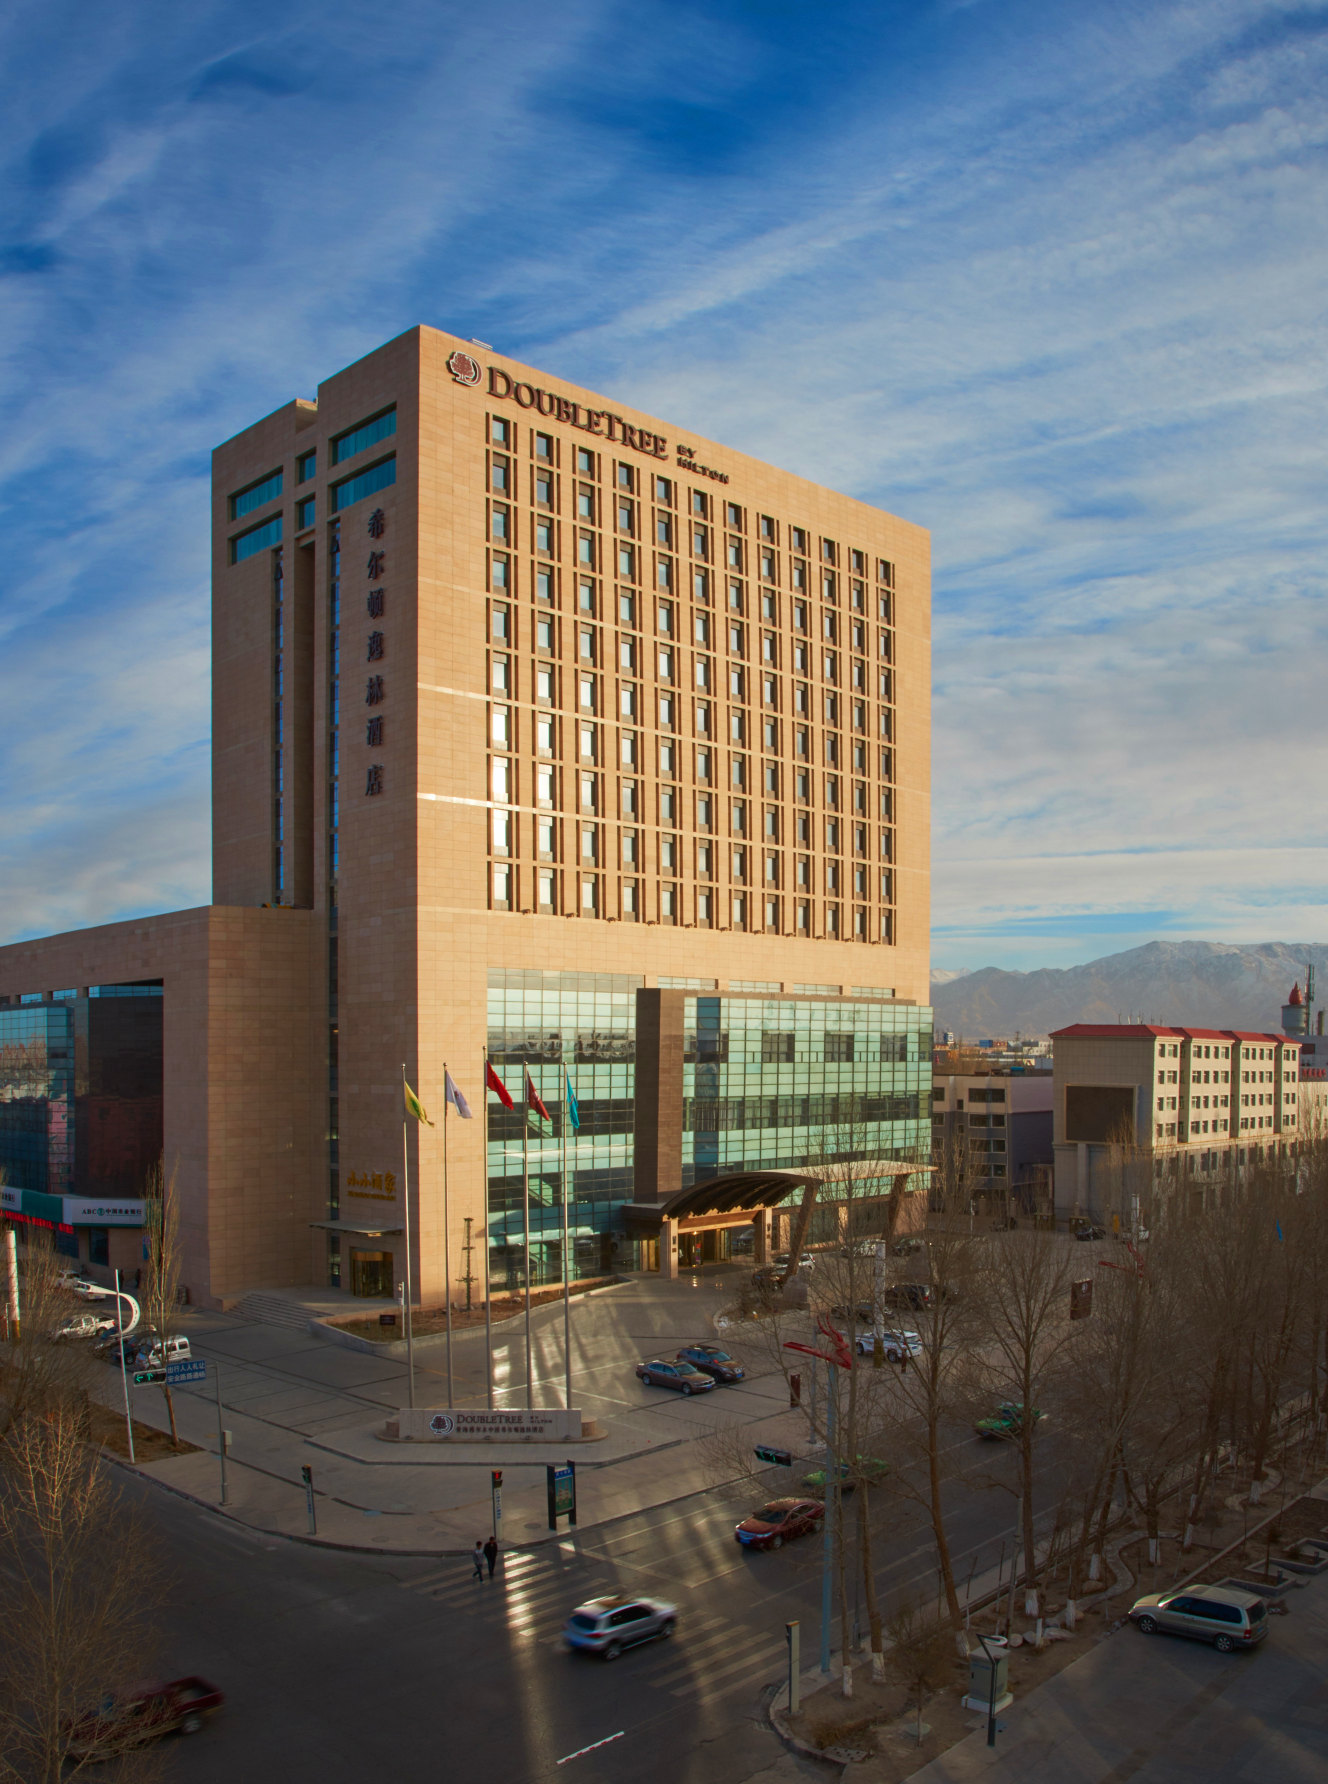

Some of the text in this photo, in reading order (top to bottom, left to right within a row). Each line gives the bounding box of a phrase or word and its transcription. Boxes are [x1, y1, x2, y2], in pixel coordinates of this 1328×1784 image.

[487, 366, 669, 460] DOUBLETREE
[676, 444, 697, 458] BY
[676, 457, 729, 484] HILTON
[366, 508, 384, 797] 希尔顿逸林酒店
[456, 1414, 523, 1424] DOUBLETREE
